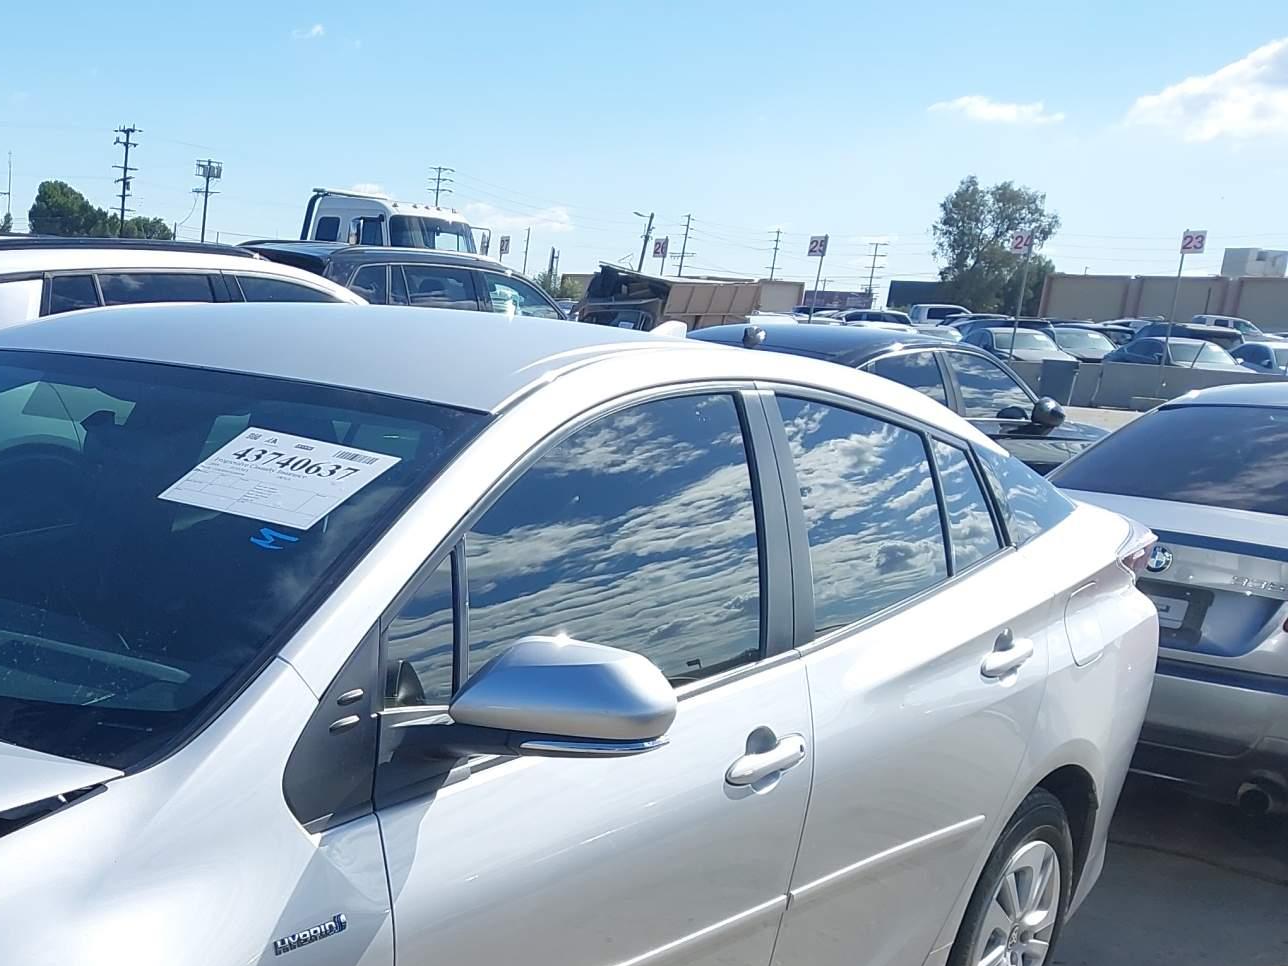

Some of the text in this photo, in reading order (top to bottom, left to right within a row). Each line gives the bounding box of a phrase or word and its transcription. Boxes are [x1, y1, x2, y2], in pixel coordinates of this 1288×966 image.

[1014, 235, 1032, 250] 24
[1182, 234, 1205, 250] 23
[232, 447, 361, 481] 43740637
